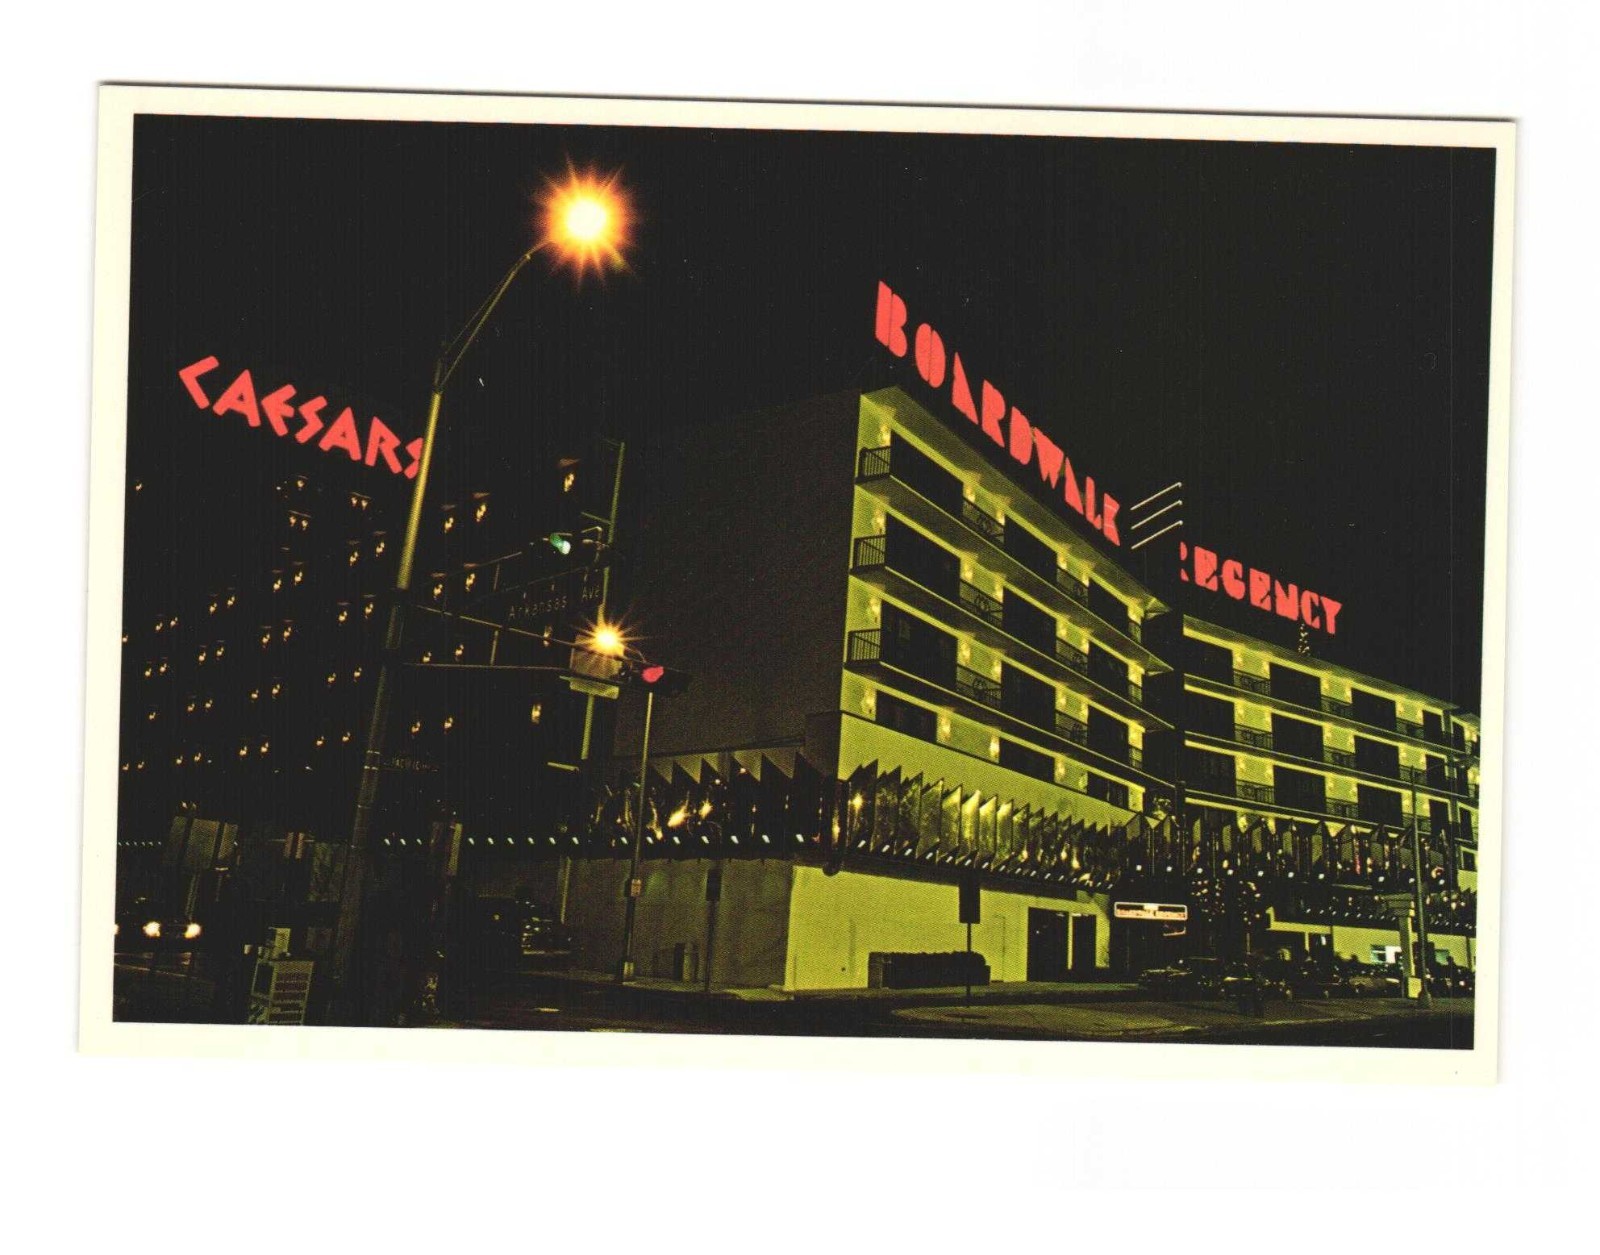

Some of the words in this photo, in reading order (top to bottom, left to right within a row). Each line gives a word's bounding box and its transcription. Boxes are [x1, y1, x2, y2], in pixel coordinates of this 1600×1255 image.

[875, 280, 1122, 546] BOARDWALK
[1180, 540, 1343, 635] EGENCY
[508, 595, 568, 619] Arkansas
